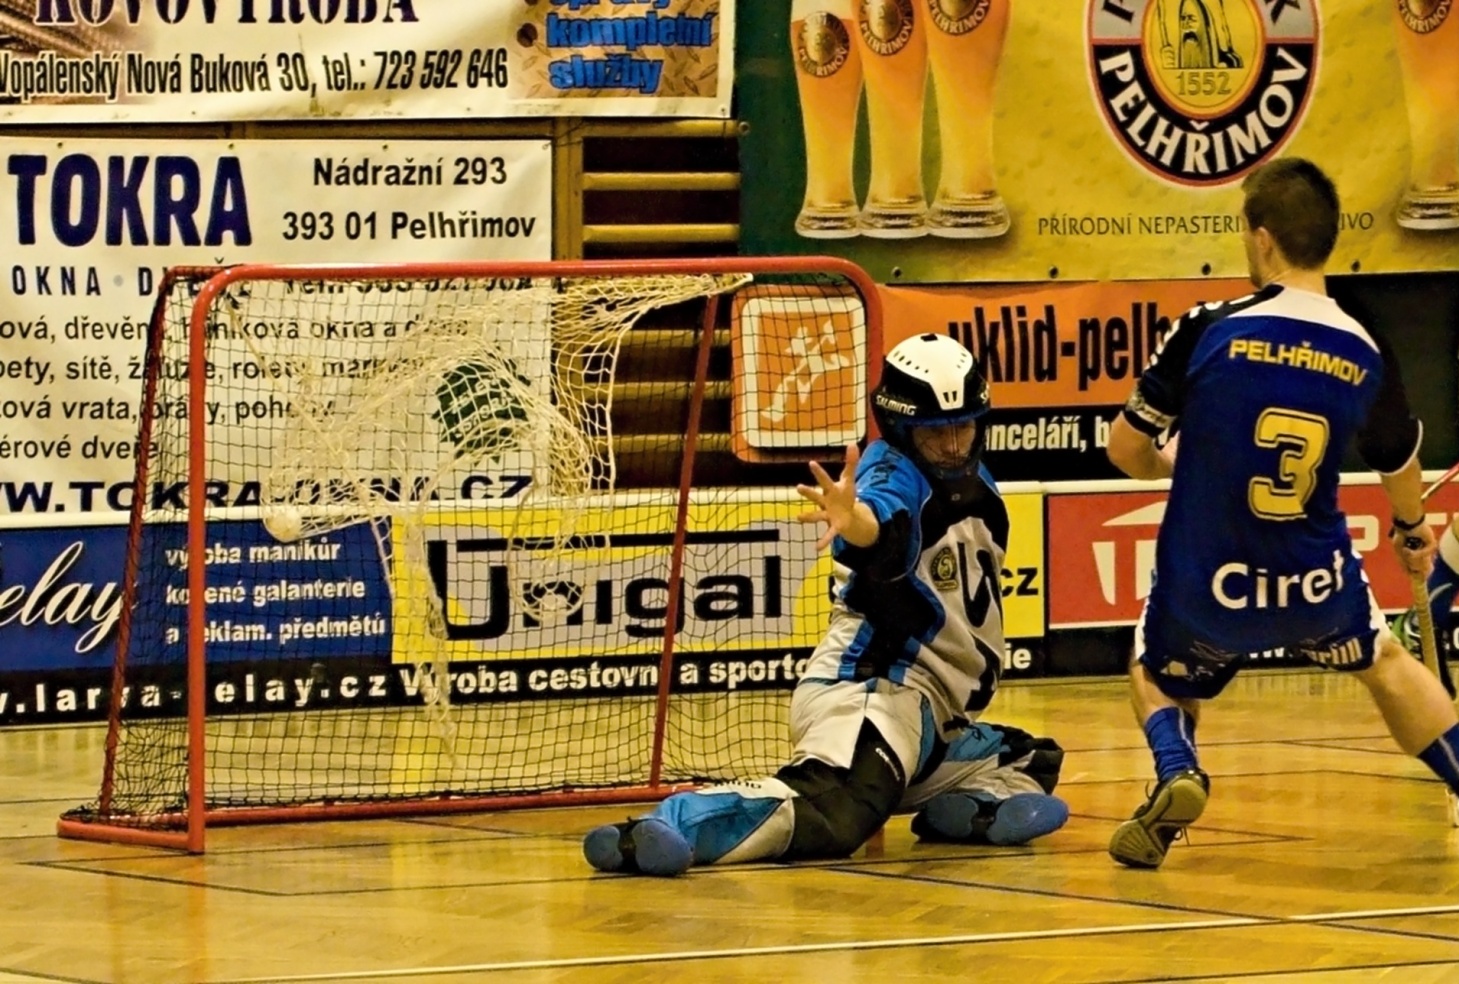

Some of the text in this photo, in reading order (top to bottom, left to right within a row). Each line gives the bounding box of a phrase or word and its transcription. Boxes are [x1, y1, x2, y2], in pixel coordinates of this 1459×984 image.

[546, 11, 717, 50] kompletní
[127, 52, 182, 95] Nová
[190, 53, 272, 94] Buková
[277, 52, 318, 99] 30,
[322, 53, 367, 92] tel.:
[374, 51, 417, 91] 723
[420, 50, 459, 90] 592
[466, 48, 509, 90] 646
[549, 53, 664, 94] služby
[1176, 72, 1232, 96] 1552
[1099, 47, 1308, 174] PELHŘIMOV
[313, 156, 508, 187] Nádražní 293
[8, 153, 253, 247] TOKRA
[282, 210, 537, 241] 393 01 Pelhřimov
[1138, 212, 1246, 236] NEPASTERI
[12, 264, 102, 297] OKNA
[310, 317, 375, 340] okna
[383, 319, 397, 338] a
[66, 355, 120, 384] sítě,
[1228, 339, 1369, 386] PELHŘIMOV
[62, 397, 138, 423] vrata,
[1247, 407, 1331, 520] 3
[166, 537, 341, 570] výoba manikůr
[166, 577, 366, 606] koené galanterie
[427, 530, 783, 641] Unigal
[1211, 549, 1345, 610] Ciret
[166, 611, 386, 645] a eklam. předmětů
[528, 659, 662, 692] cestovn
[679, 662, 698, 685] a
